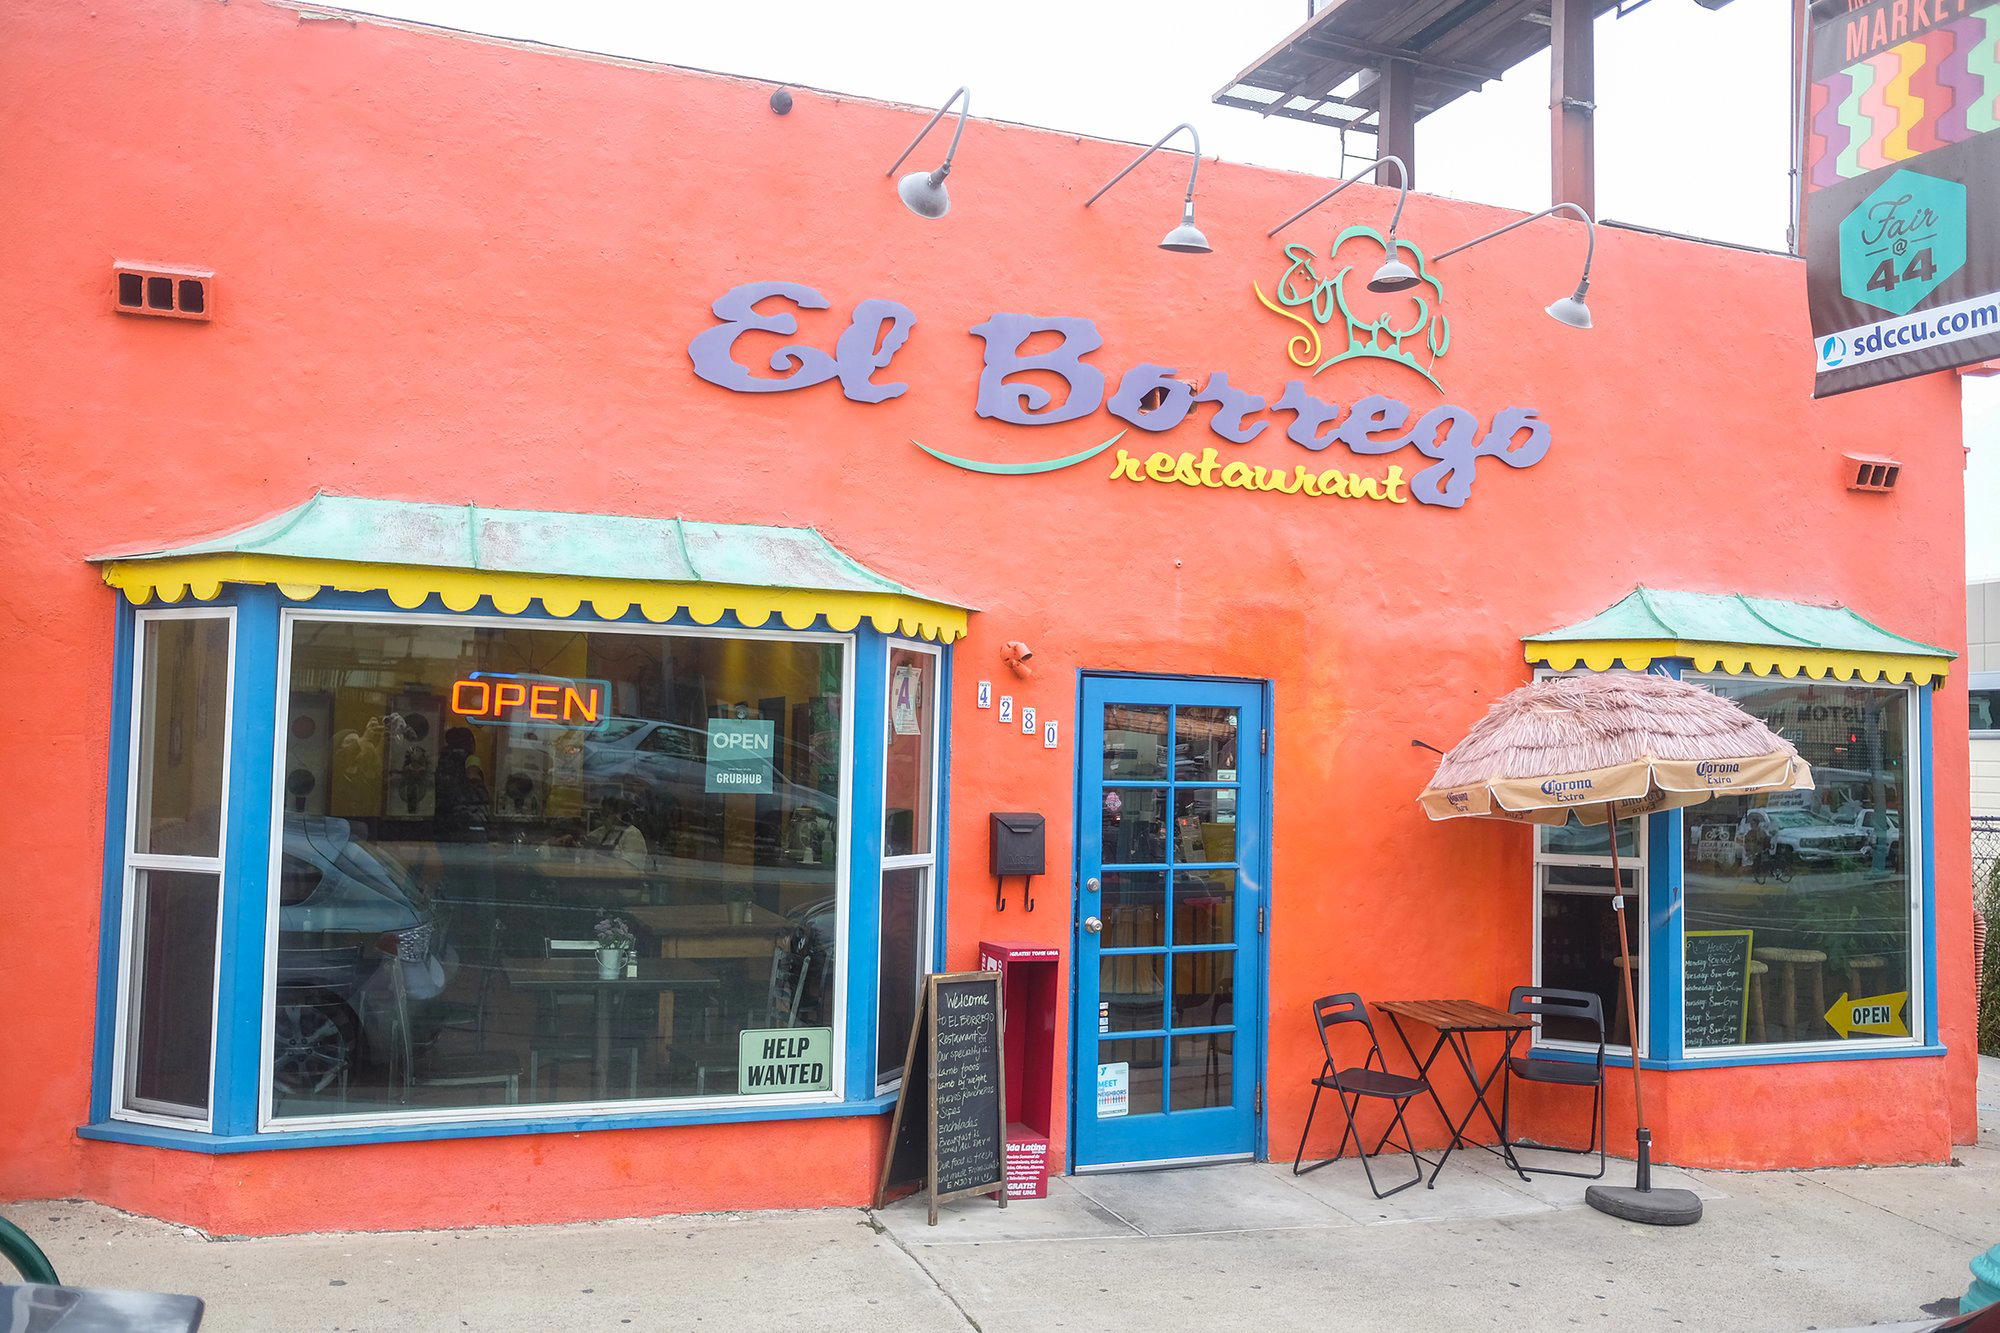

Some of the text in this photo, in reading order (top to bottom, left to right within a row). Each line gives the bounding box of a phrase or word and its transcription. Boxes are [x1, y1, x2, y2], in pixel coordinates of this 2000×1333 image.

[1846, 0, 1965, 61] MARKE
[1862, 194, 1939, 245] Fair
[1866, 247, 1937, 292] 44
[1854, 304, 1998, 356] sdccu.com
[688, 281, 1552, 508] El Borrego
[1109, 447, 1408, 505] restaurant
[451, 680, 598, 722] OPEN
[897, 677, 911, 709] A
[713, 732, 769, 749] OPEN
[716, 773, 762, 784] GRUBHUB
[1696, 762, 1740, 779] Corona
[1707, 774, 1732, 785] Extra
[1541, 779, 1593, 796] Corona
[1556, 793, 1585, 802] Extra
[944, 992, 990, 1009] Welcome
[1853, 1006, 1890, 1025] OPEN
[763, 1037, 810, 1059] HELP
[748, 1063, 824, 1086] WANTED
